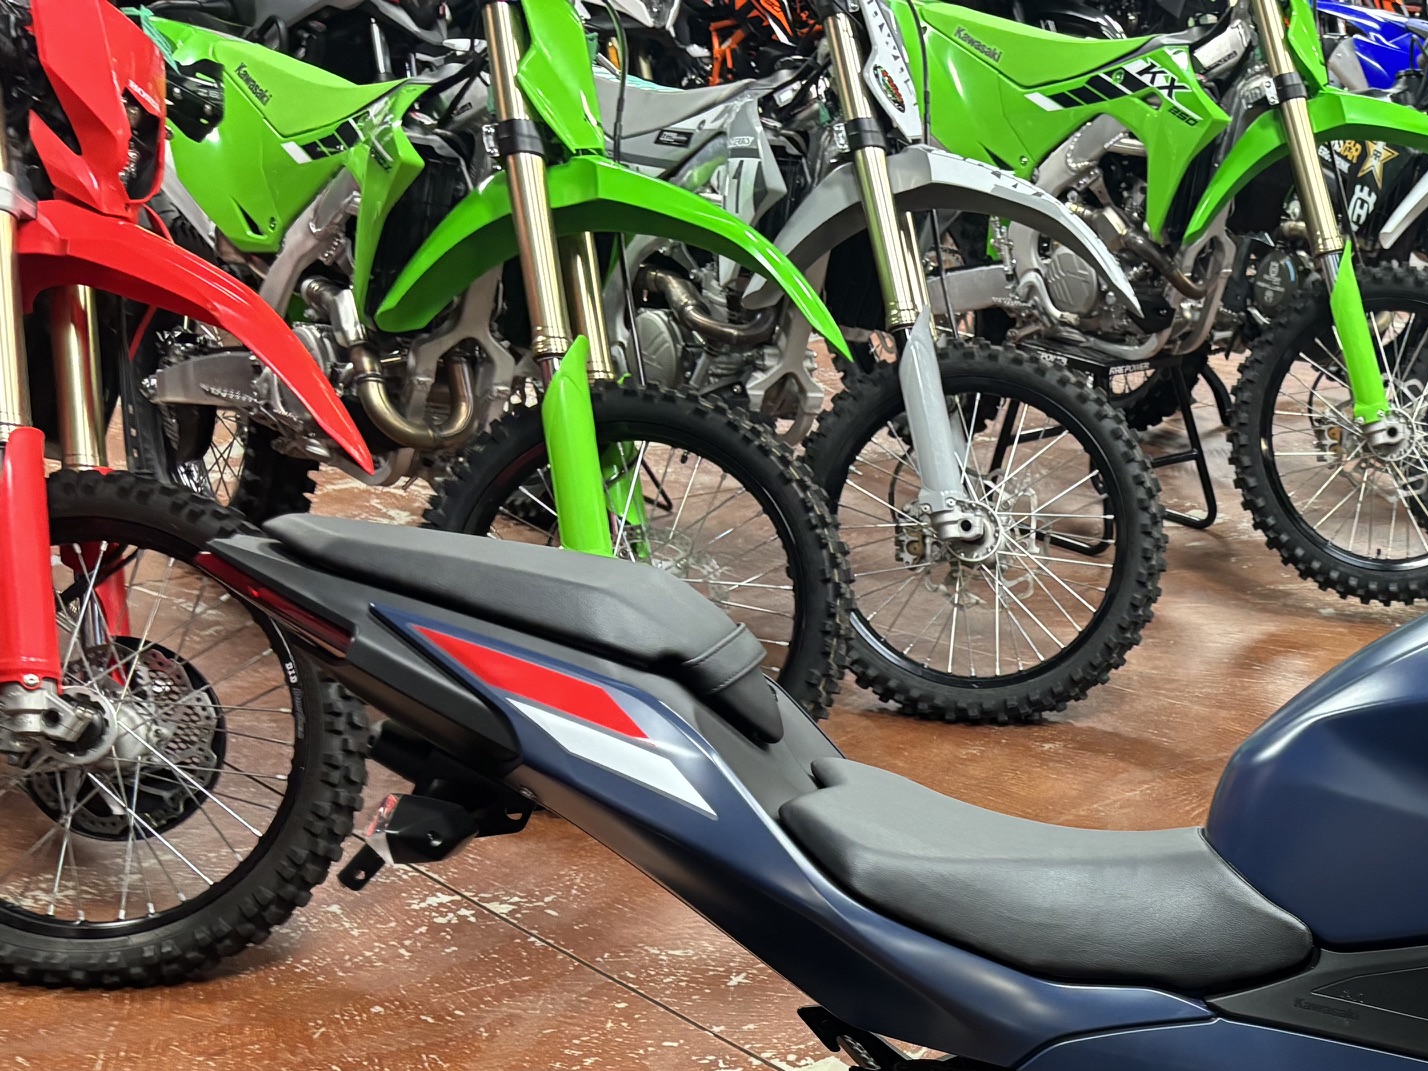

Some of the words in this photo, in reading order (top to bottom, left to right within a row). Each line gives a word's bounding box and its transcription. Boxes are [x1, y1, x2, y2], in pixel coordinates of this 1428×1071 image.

[954, 26, 1002, 62] Kawasaki
[235, 62, 272, 106] Kawasaki
[1135, 61, 1191, 100] KX
[1168, 106, 1198, 126] 250
